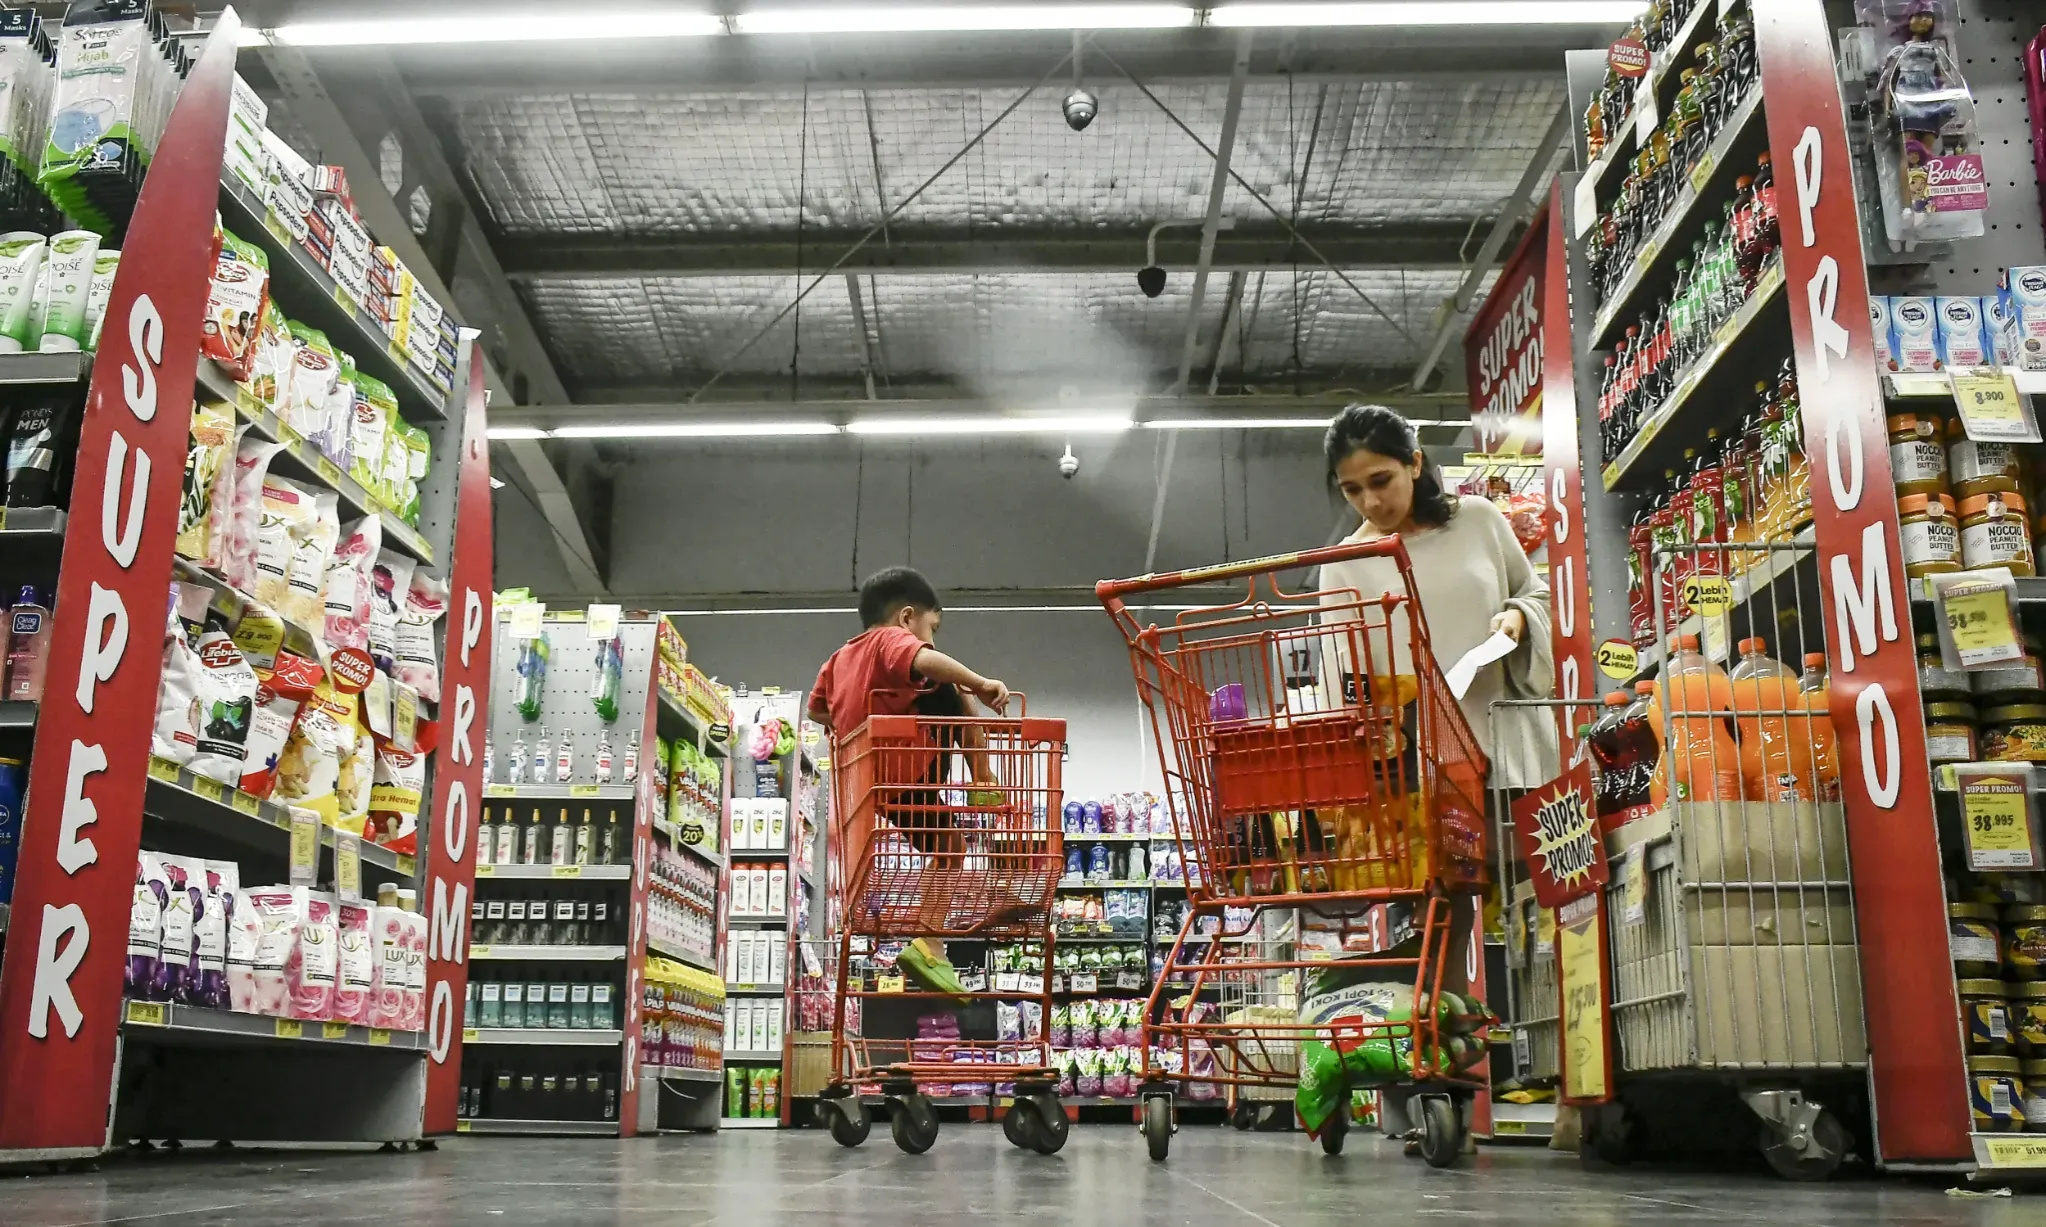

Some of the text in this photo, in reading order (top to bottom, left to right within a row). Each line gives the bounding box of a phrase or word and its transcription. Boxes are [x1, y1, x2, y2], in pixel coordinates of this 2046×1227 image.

[120, 7, 143, 15] Masks
[4, 24, 27, 32] Masks
[12, 15, 21, 25] 5
[1613, 44, 1645, 58] SUPER
[1611, 54, 1647, 67] PROMO!
[1927, 159, 1982, 185] Barbie
[276, 160, 310, 206] Pepsodent
[270, 190, 305, 236] Pepsodent
[335, 205, 367, 247] Pepsodent
[334, 233, 365, 274] Pepsodent
[332, 260, 363, 302] Pepsodent
[414, 286, 442, 318] Pepsodent
[411, 311, 436, 344] Pepsodent
[1479, 275, 1539, 396] SUPER
[408, 335, 433, 369] Pepsodent
[1975, 391, 2004, 405] 8.900
[16, 418, 50, 431] MEN
[1793, 126, 1899, 808] PROMO
[1929, 535, 1954, 543] PEANUT
[1988, 525, 2021, 537] NOCCIO
[1990, 535, 2017, 544] PEANUT
[1930, 542, 1954, 550] BUTTER
[1990, 542, 2018, 551] BUTTER
[1686, 585, 1700, 605] 2
[1700, 585, 1727, 597] Lebih
[1944, 589, 1969, 598] SUPER
[339, 652, 371, 676] SUPER
[1288, 650, 1310, 672] 17
[1600, 650, 1612, 667] 2
[1611, 651, 1635, 663] Lebih
[28, 293, 163, 1039] SUPER
[332, 660, 369, 686] PROMO!
[1966, 785, 2022, 793] SUPER PROMO!
[388, 792, 416, 806] Hemat
[429, 586, 482, 1065] PROMO
[1540, 791, 1585, 843] SUPER
[683, 831, 703, 842] 20%
[1548, 830, 1596, 880] PROMO!
[625, 771, 649, 1092] SUPER
[1311, 993, 1341, 1009] KOKI
[1345, 988, 1374, 1000] TOPI
